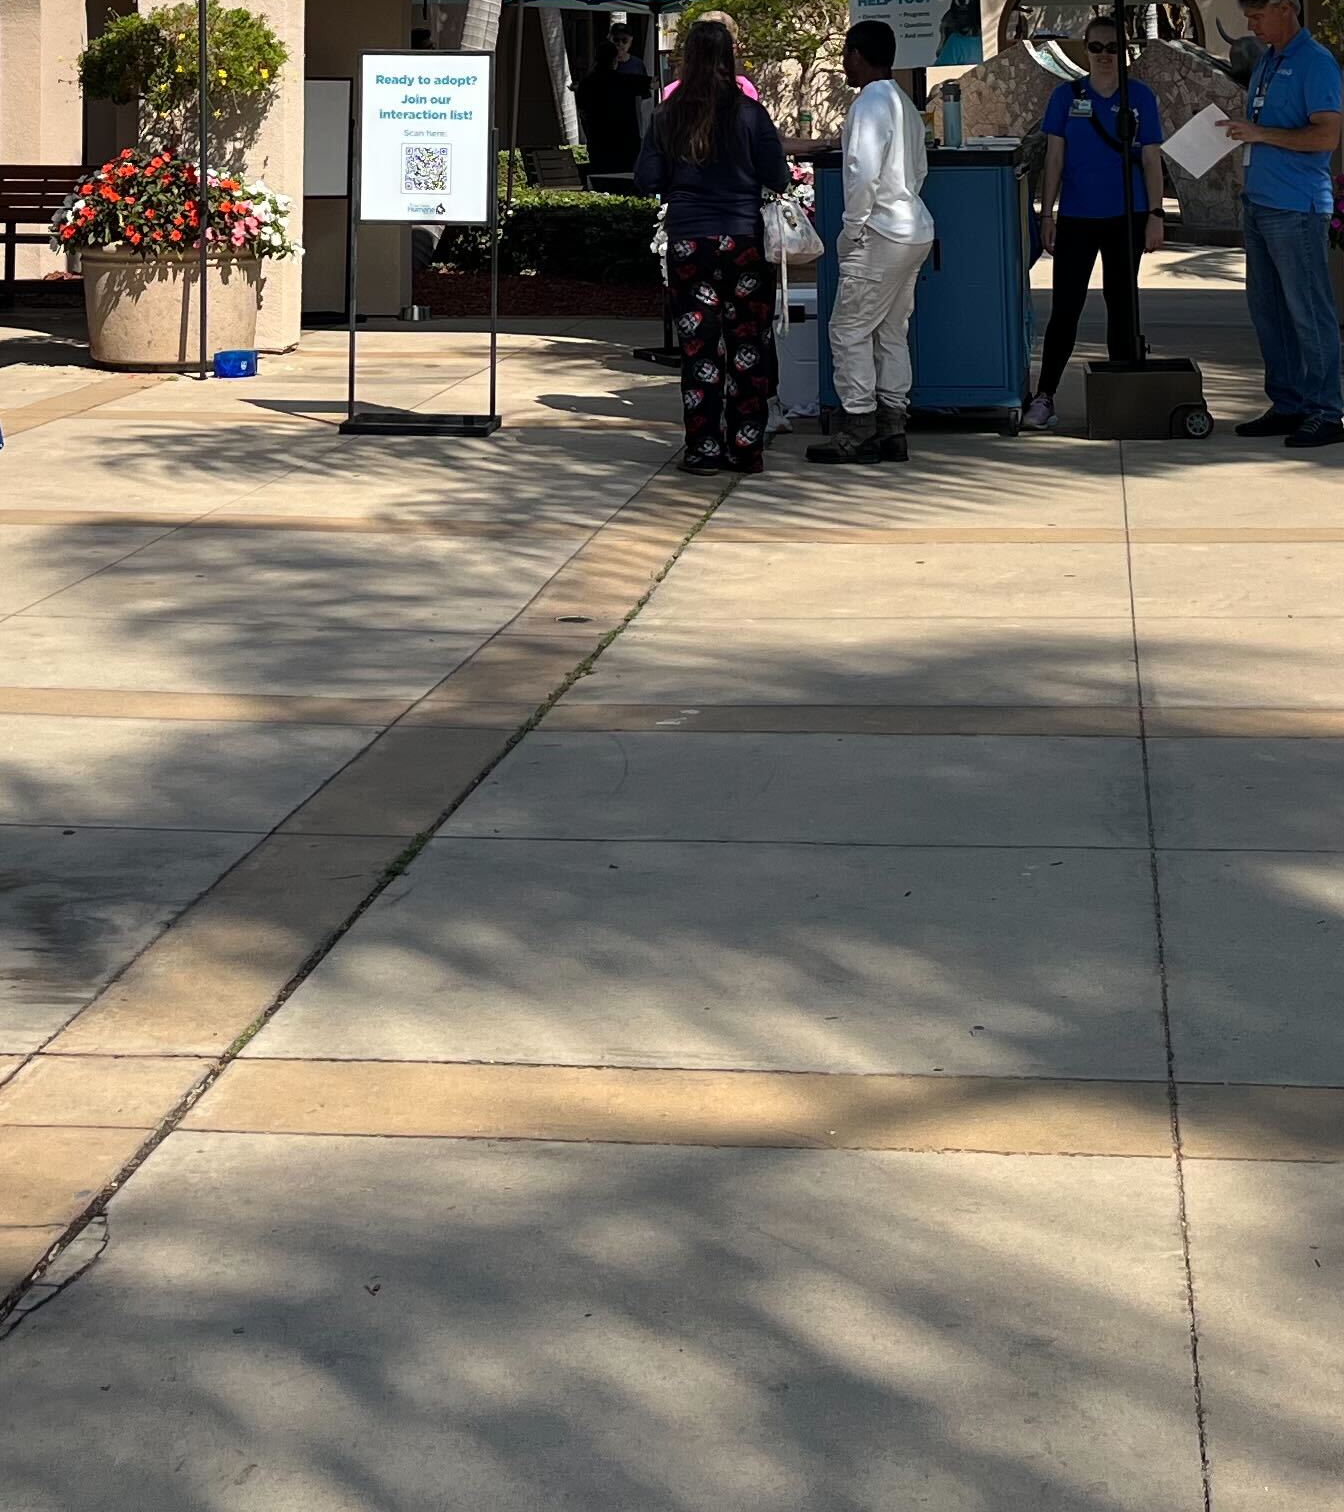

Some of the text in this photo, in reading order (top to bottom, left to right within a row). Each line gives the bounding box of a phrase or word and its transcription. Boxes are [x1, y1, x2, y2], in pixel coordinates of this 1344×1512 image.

[375, 75, 477, 87] Ready to adopt?
[401, 94, 451, 104] Join our
[379, 109, 473, 120] interaction list!
[404, 129, 424, 137] Scan
